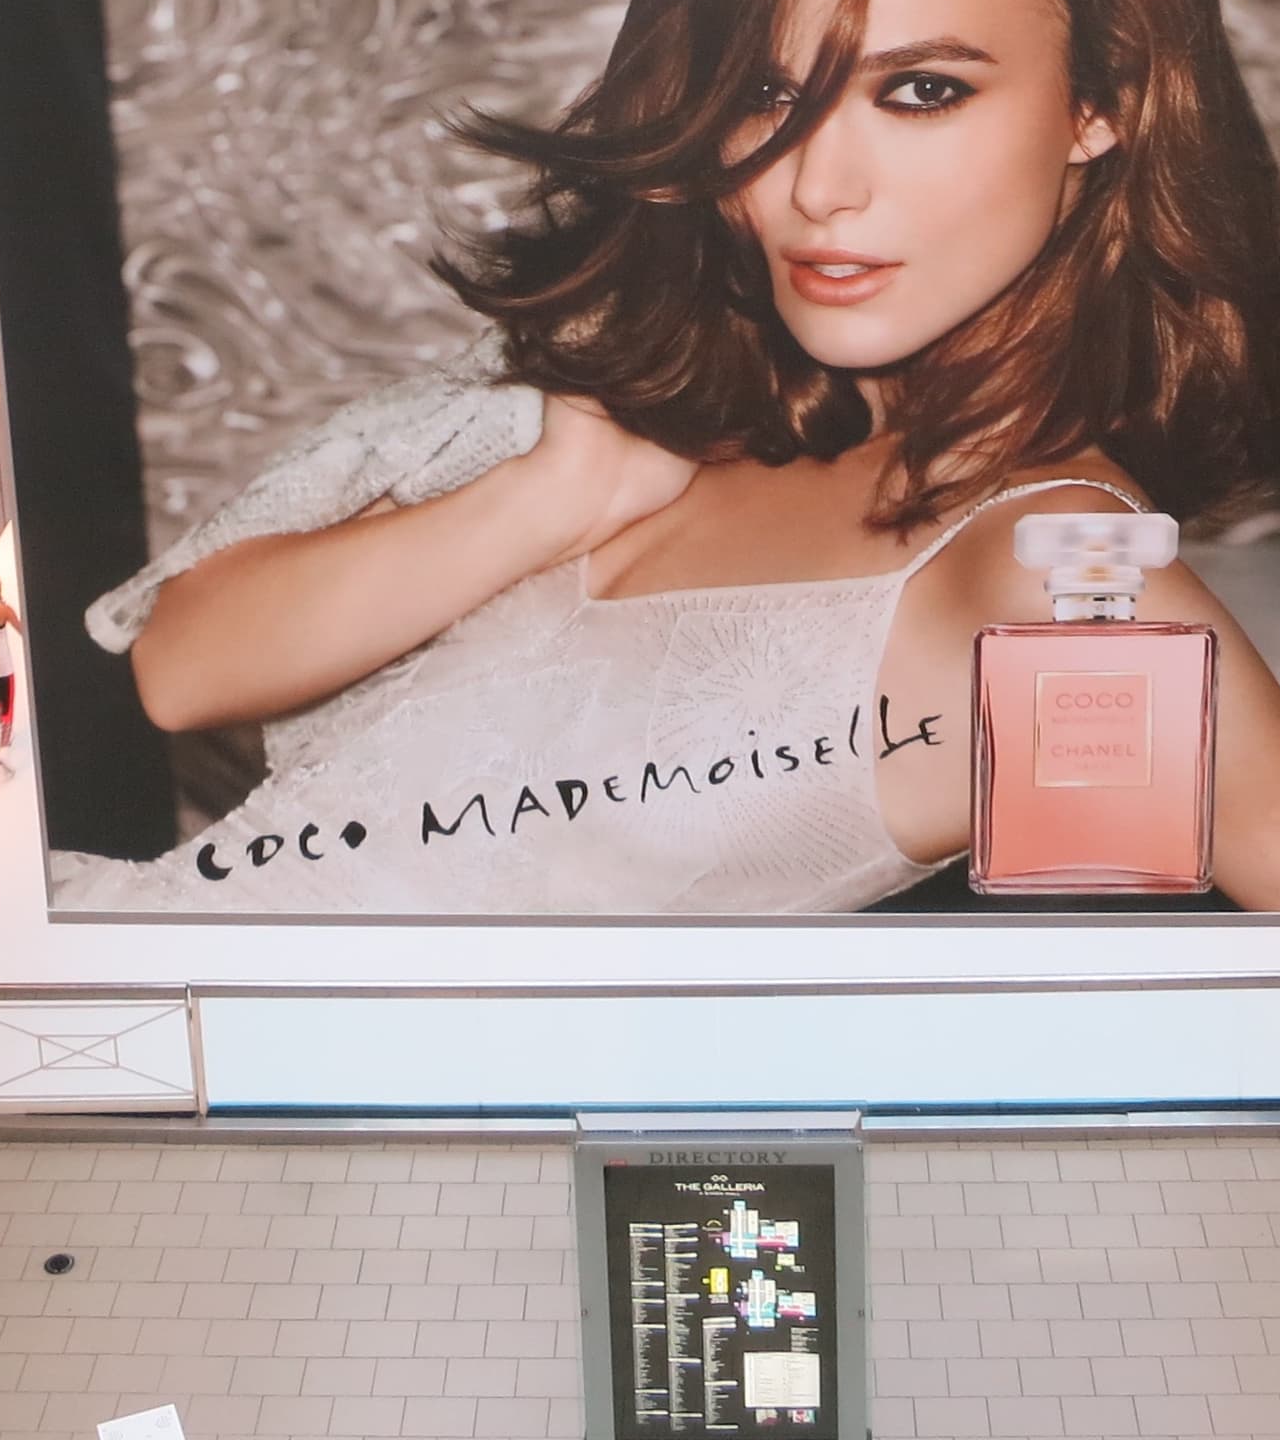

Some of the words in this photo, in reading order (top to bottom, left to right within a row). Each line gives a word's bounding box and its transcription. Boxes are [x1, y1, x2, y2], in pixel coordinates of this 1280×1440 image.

[1055, 692, 1134, 709] COCO
[1050, 743, 1136, 758] CHANEL
[197, 820, 368, 880] COCO
[649, 1151, 787, 1164] DIRECTORY
[674, 1183, 701, 1192] THE
[703, 1182, 766, 1192] GALLERIA
